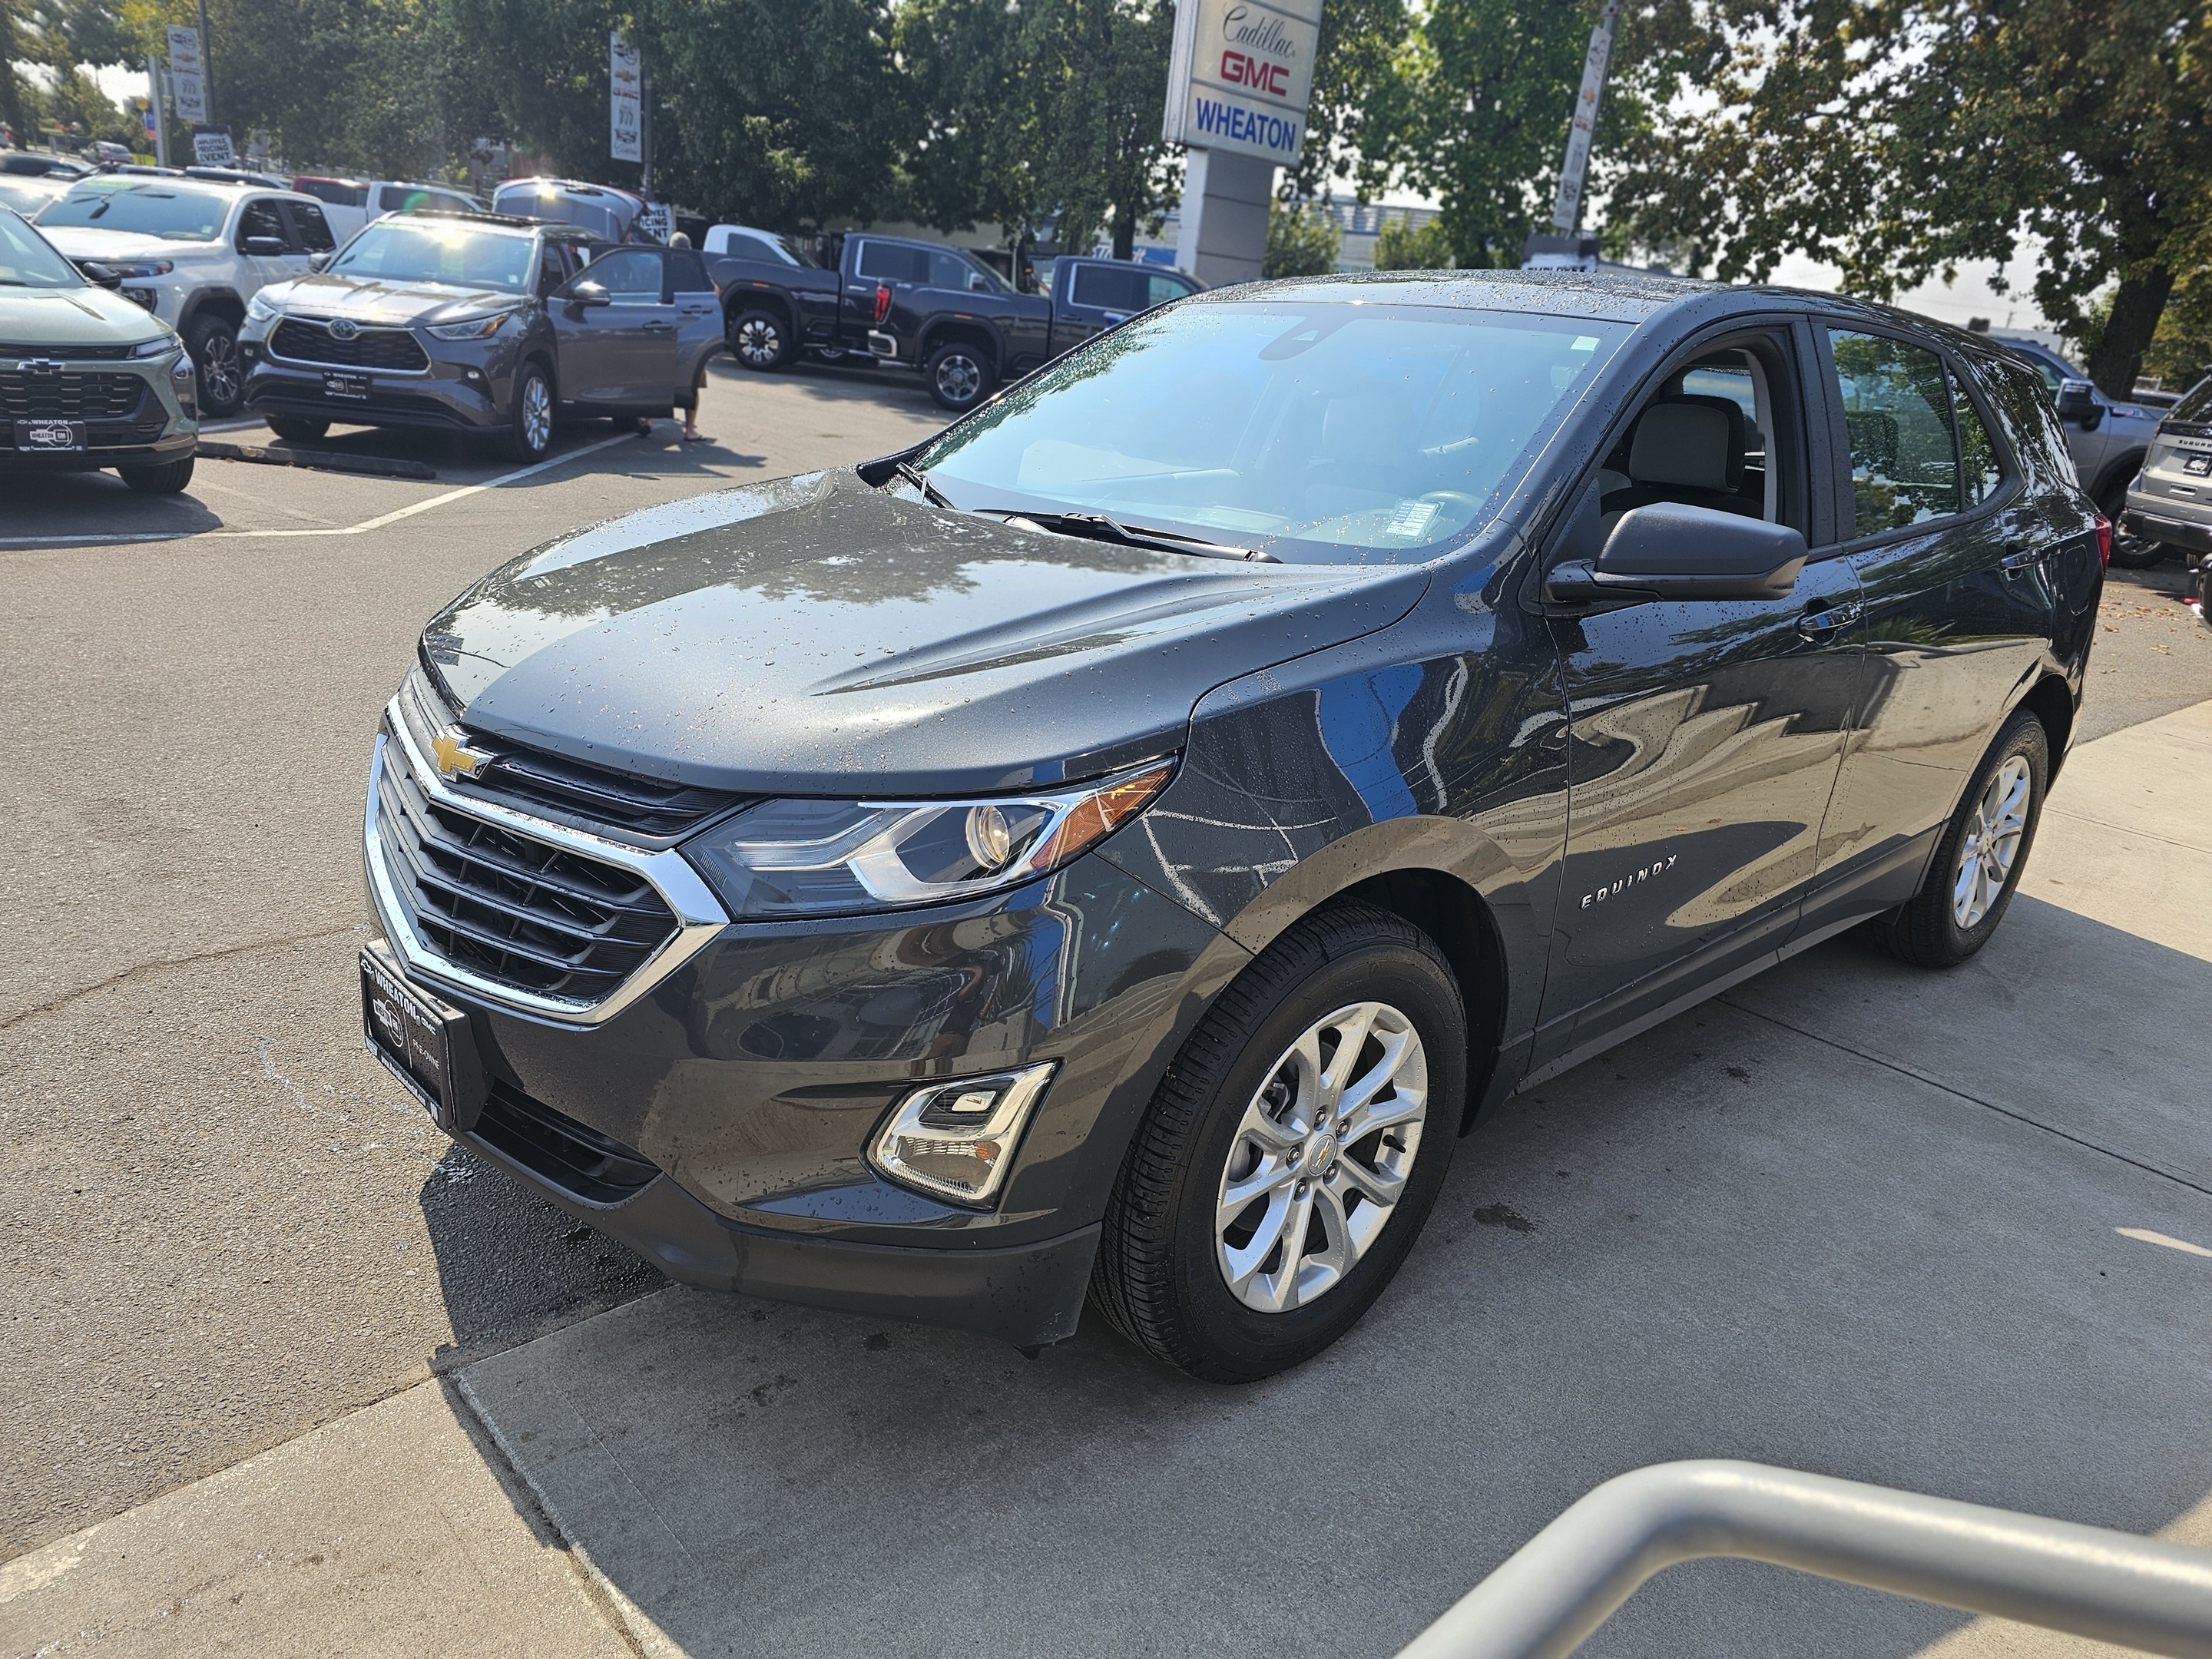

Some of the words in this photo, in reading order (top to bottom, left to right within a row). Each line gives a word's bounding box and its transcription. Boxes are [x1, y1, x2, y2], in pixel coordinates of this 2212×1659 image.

[1223, 5, 1293, 58] Cadillac
[1220, 50, 1290, 97] GMC
[1197, 98, 1296, 152] WHEATON
[1580, 854, 1677, 909] EQUINOX
[375, 969, 417, 1020] WHEATON
